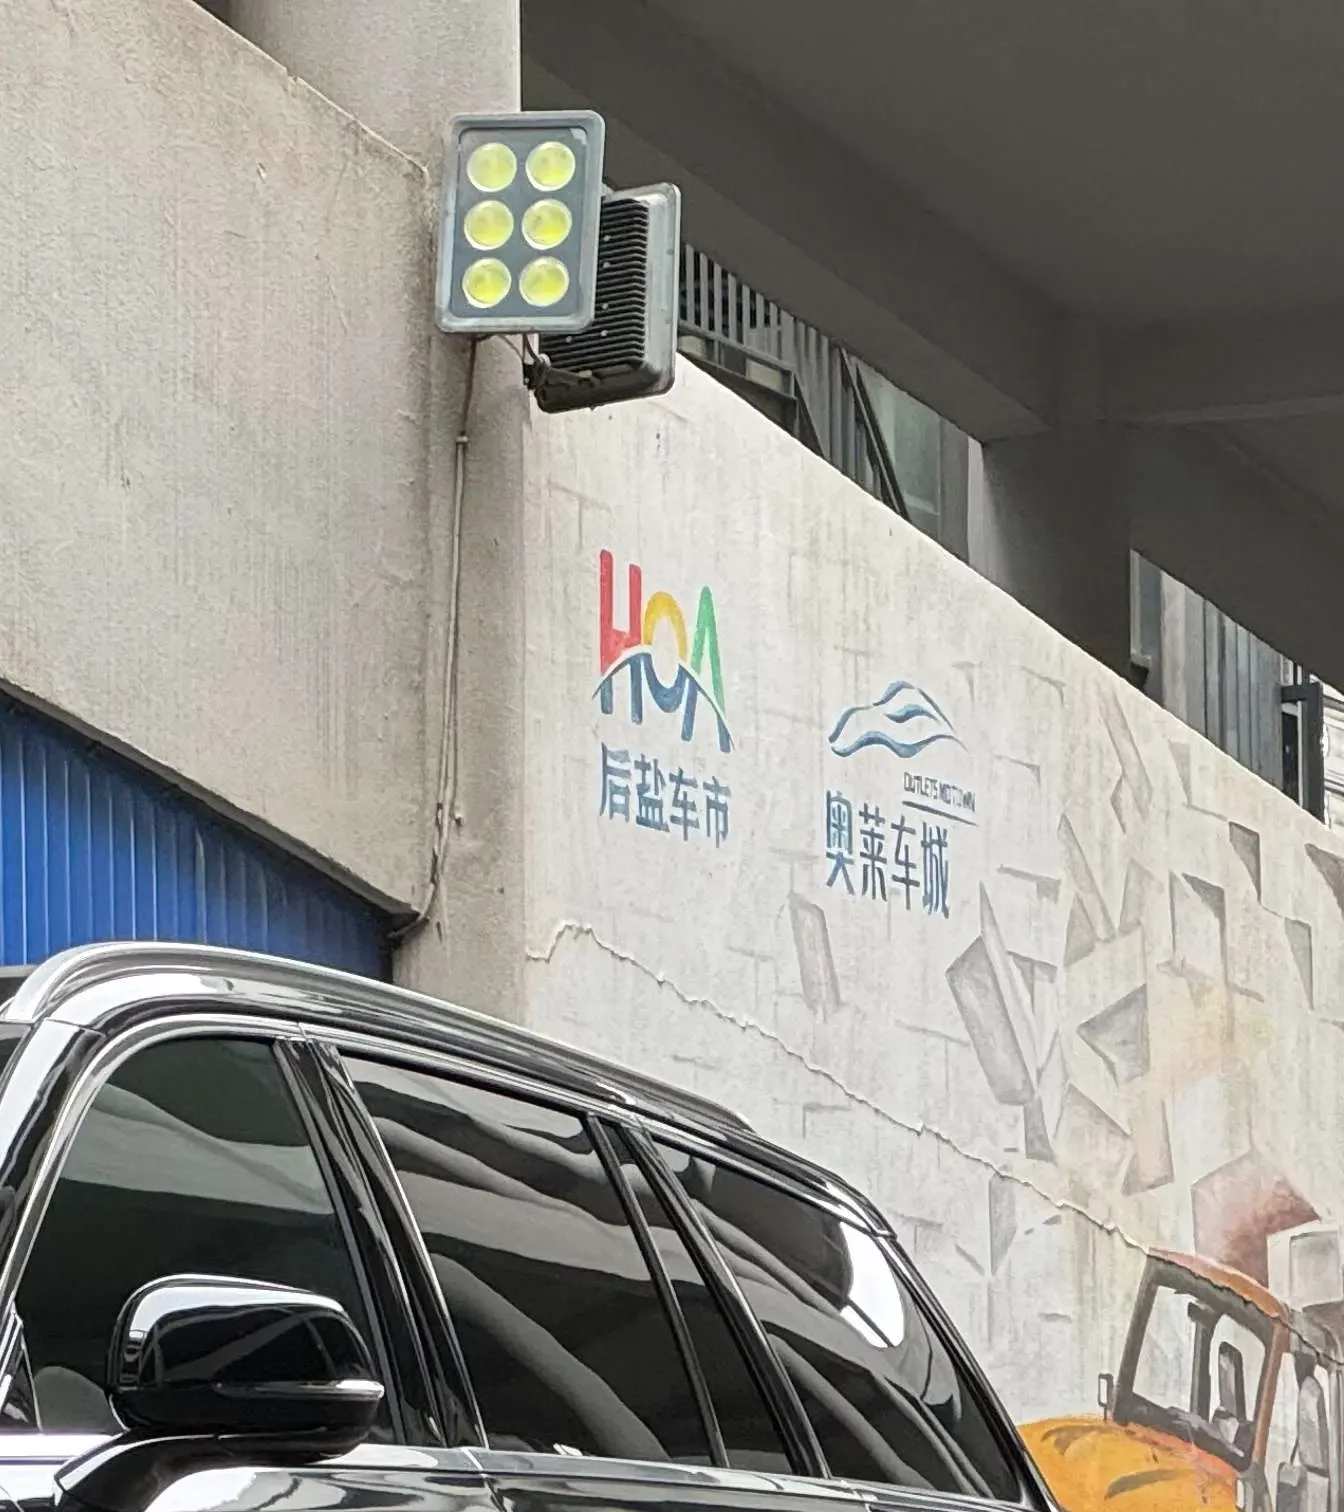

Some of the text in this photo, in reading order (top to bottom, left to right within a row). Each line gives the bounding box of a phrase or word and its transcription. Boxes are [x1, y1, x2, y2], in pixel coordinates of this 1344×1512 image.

[599, 741, 732, 849] 后盐车市
[825, 789, 950, 919] 奥莱车城
